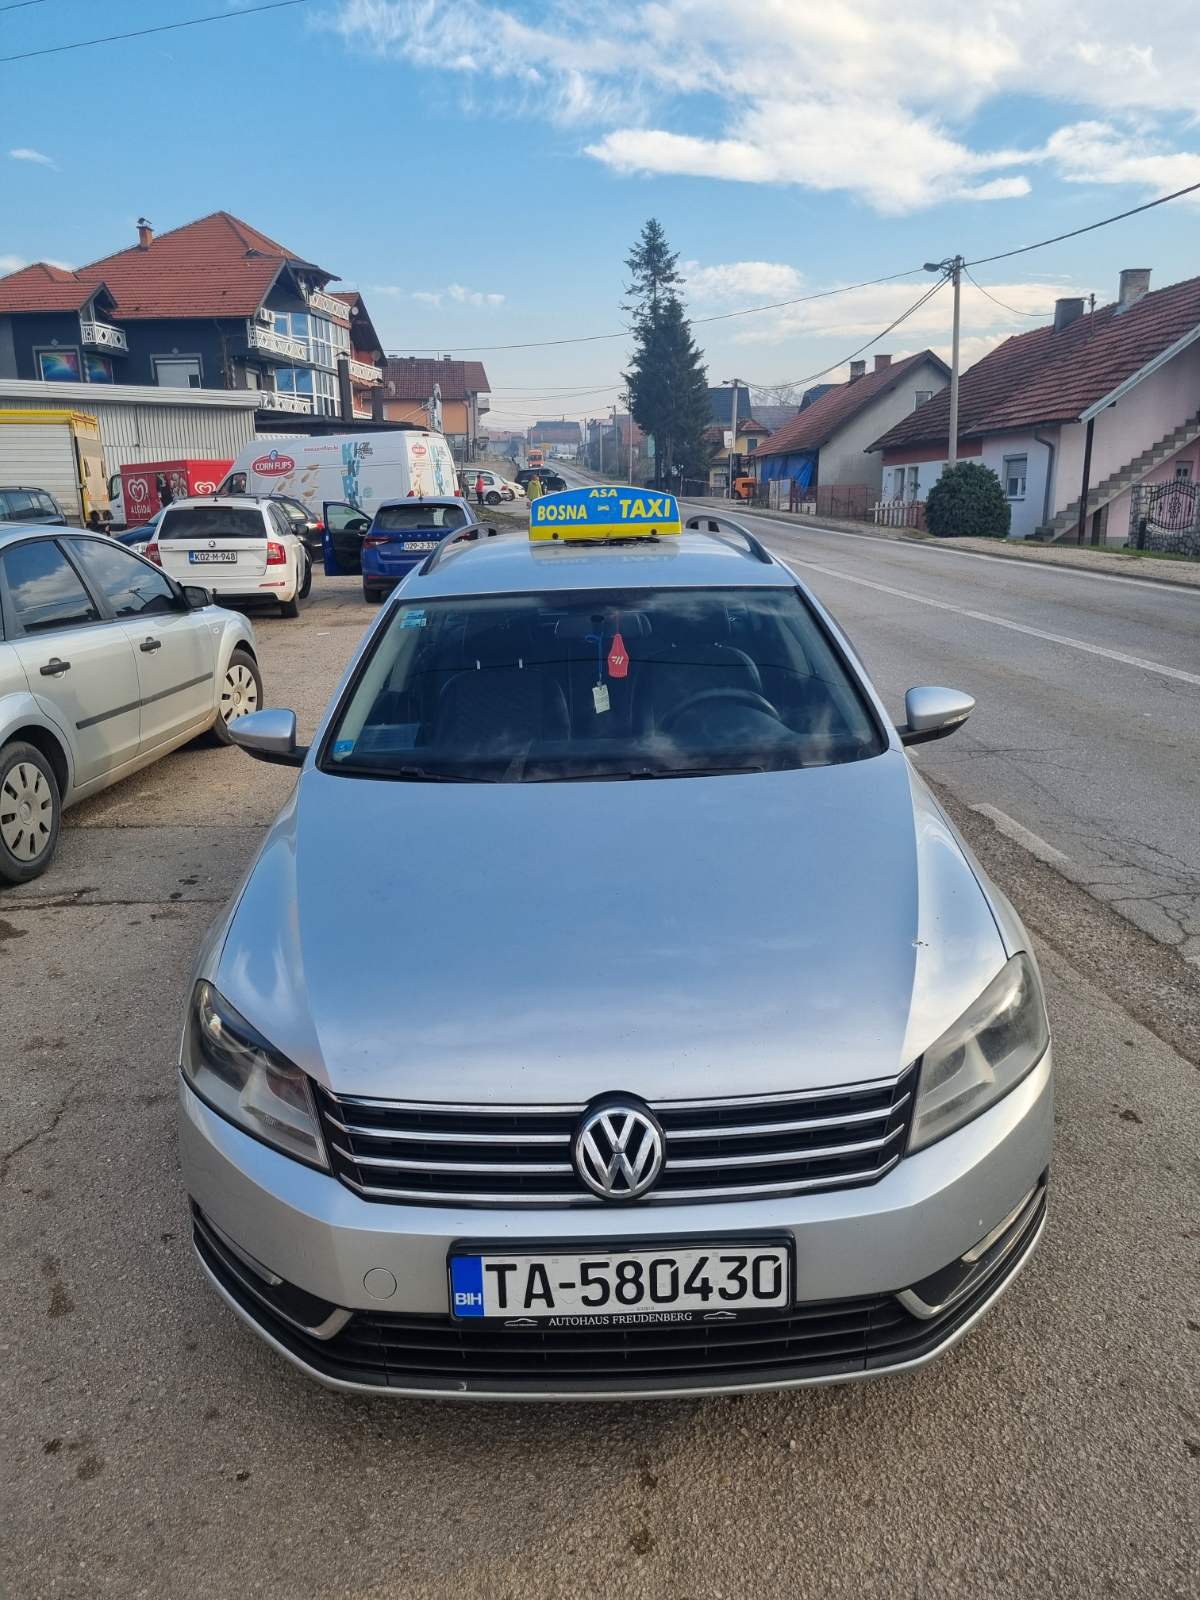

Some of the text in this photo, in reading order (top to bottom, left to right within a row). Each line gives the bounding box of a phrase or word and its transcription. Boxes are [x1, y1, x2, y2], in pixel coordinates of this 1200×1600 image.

[255, 462, 274, 471] CORN
[589, 489, 618, 498] ASA
[537, 498, 671, 521] BOSNA TAXI
[485, 1254, 782, 1309] TA-580430
[455, 1292, 482, 1306] BIH
[549, 1312, 693, 1326] AUTOHAUS FREUDENBERG
